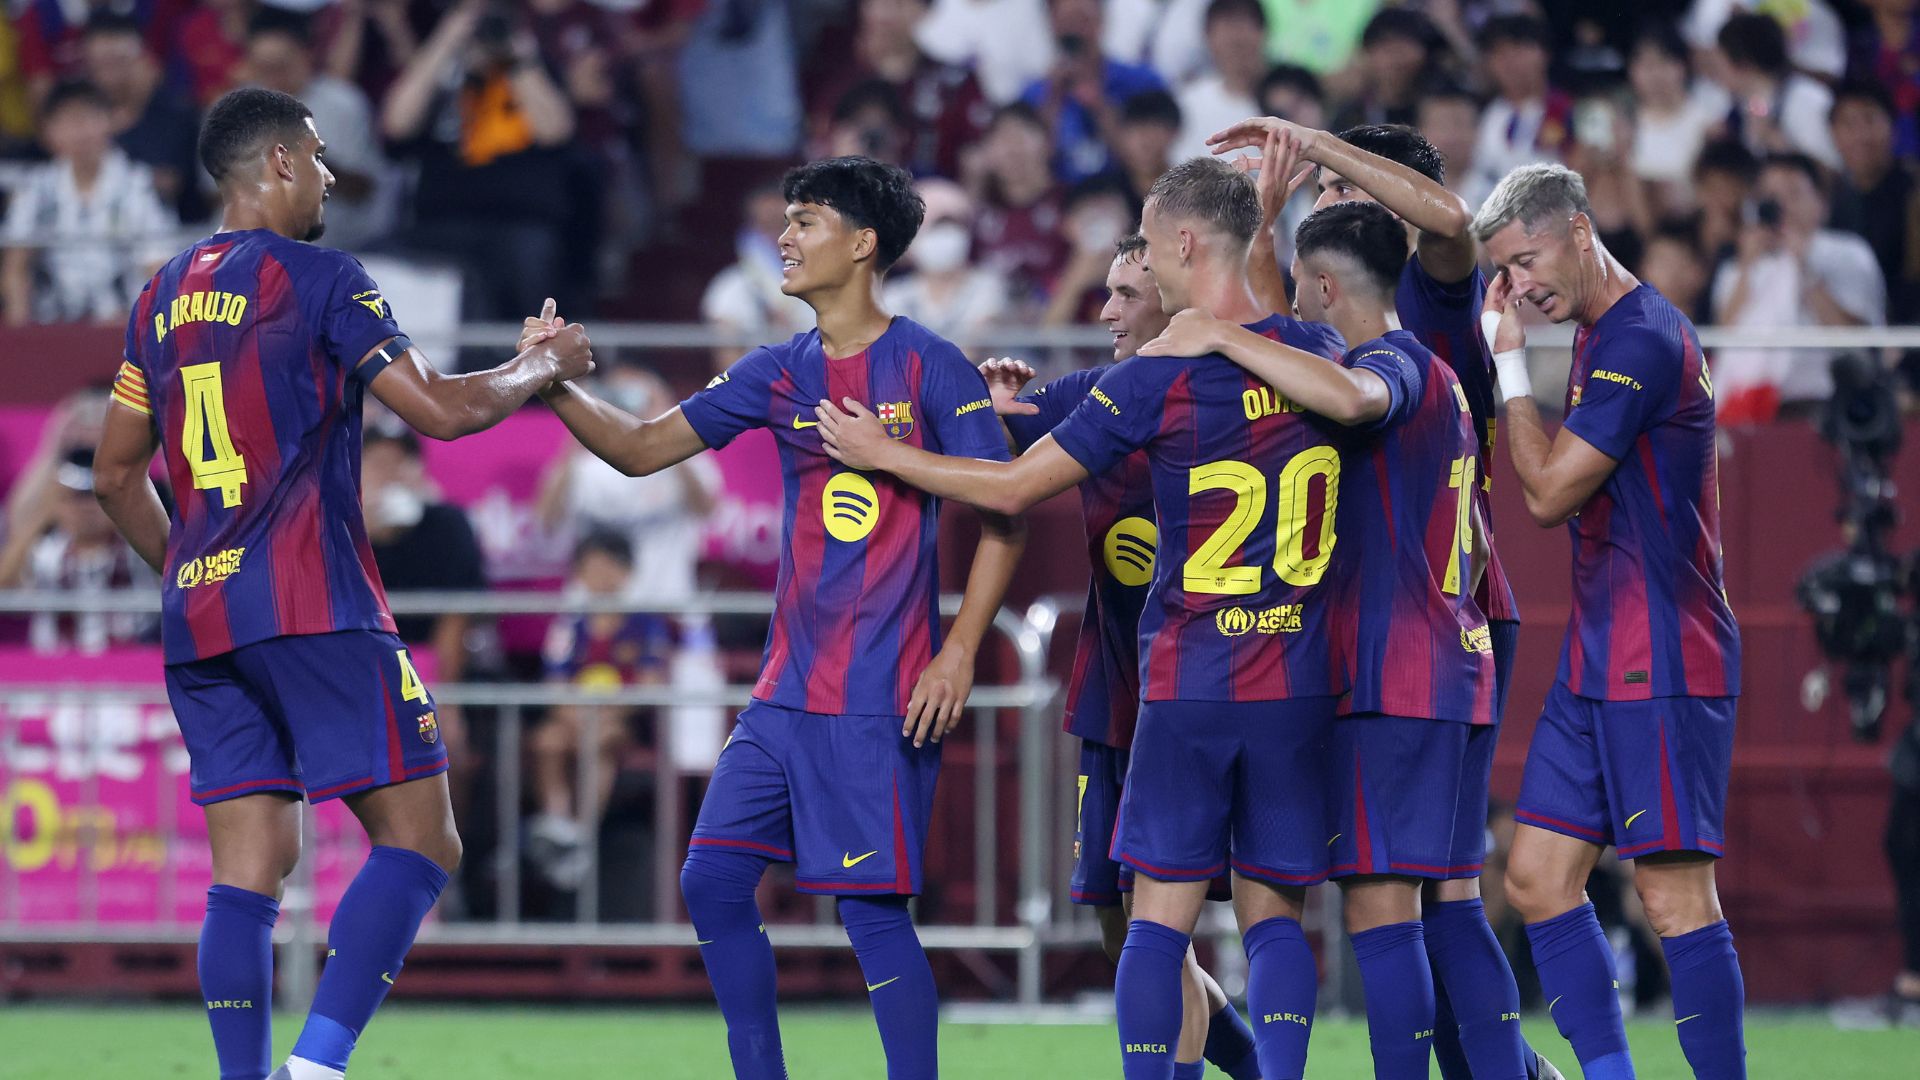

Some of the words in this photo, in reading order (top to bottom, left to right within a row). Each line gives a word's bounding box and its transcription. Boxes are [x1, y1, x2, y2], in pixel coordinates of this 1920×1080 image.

[154, 312, 168, 344] R.
[170, 291, 248, 327] ARAUJO
[179, 361, 248, 509] 4
[1183, 445, 1341, 595] 20
[396, 649, 429, 705] 4
[1263, 1012, 1308, 1027] BARÇA
[1125, 1043, 1168, 1054] BARÇA
